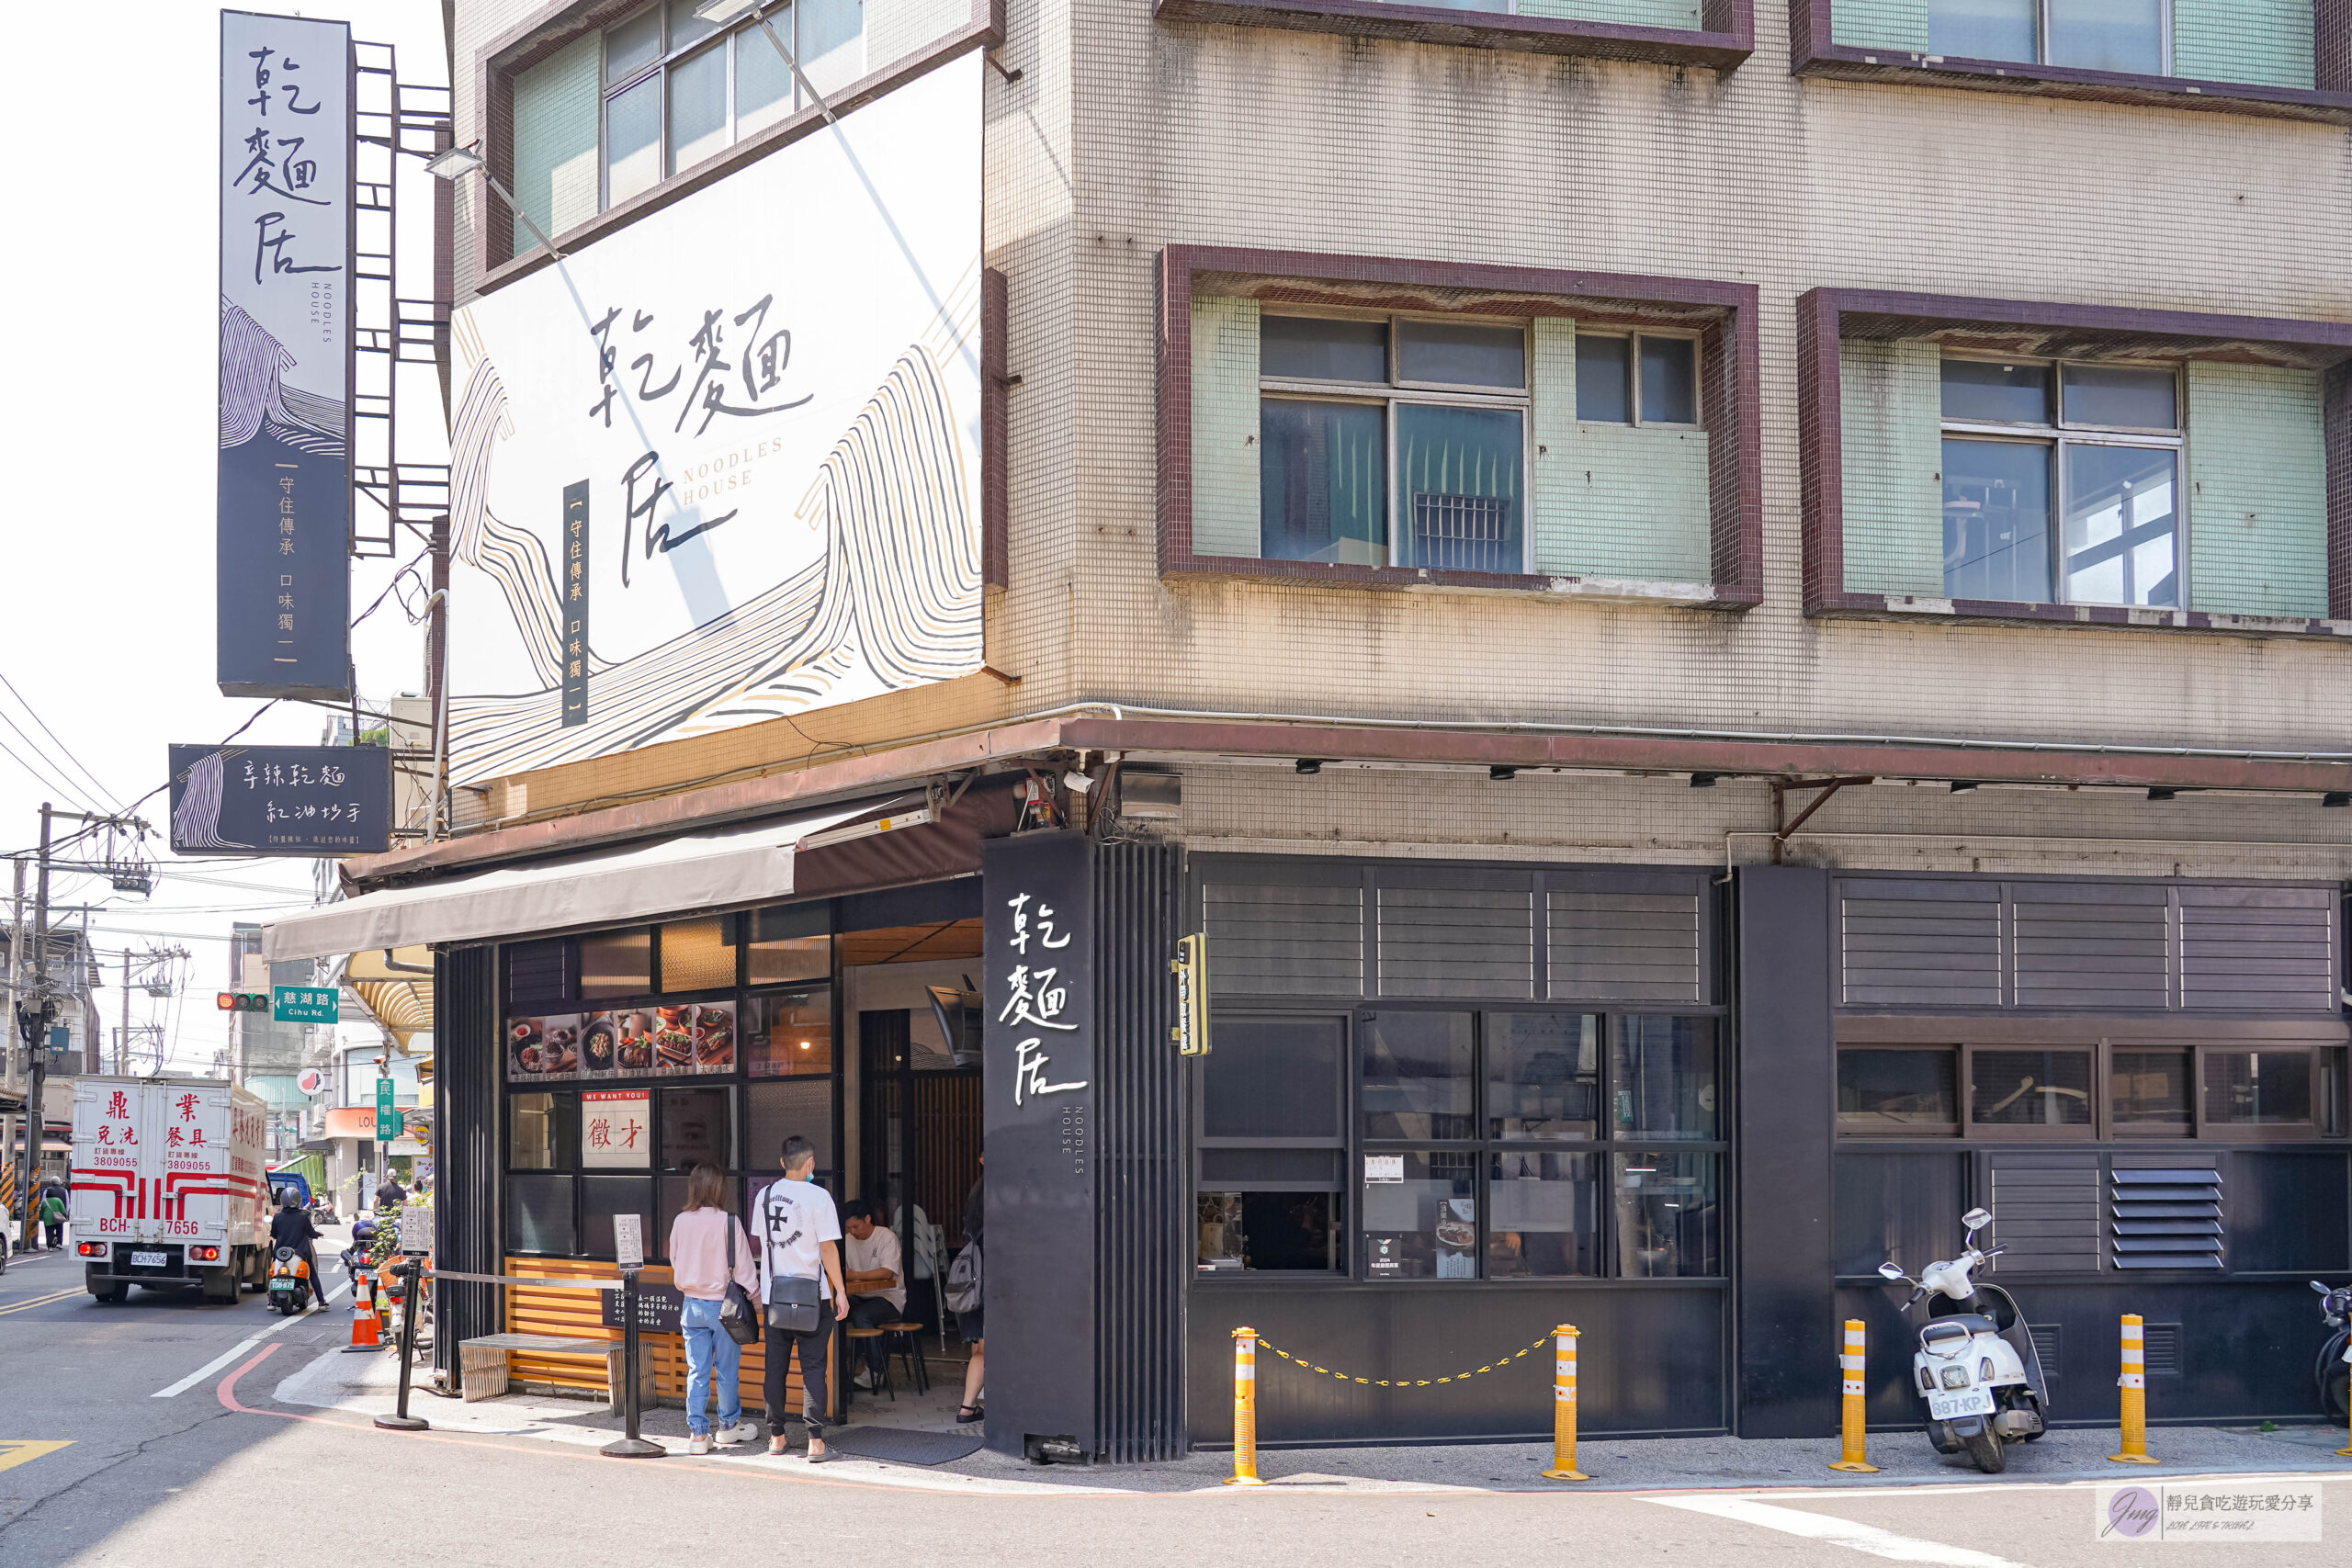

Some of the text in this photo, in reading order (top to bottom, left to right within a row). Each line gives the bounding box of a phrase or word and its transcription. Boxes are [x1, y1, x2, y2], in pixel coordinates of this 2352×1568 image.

[233, 47, 343, 285] 乾麵居
[311, 282, 320, 324] HOUSE
[323, 283, 332, 343] NOODLES
[589, 294, 814, 438] 乾麵
[684, 437, 782, 484] NOODLES
[684, 469, 752, 506] HOUSE
[621, 451, 738, 589] 居
[277, 476, 295, 644] 守住傳承 口味獨一
[243, 761, 345, 789] 辛辣乾麵
[266, 801, 361, 823] 紅油抄手
[284, 992, 329, 1006] 慈湖路
[999, 893, 1089, 1106] 乾麵居
[358, 1116, 377, 1128] LOU
[379, 1084, 391, 1135] 民權路
[96, 1125, 208, 1148] 免洗 餐具
[588, 1118, 642, 1150] 徵才
[1062, 1107, 1071, 1154] HOUSE
[1075, 1107, 1084, 1173] NOODLES
[94, 1156, 138, 1167] 3809055
[167, 1160, 210, 1170] 3809055
[166, 1221, 198, 1235] 7656
[1931, 1394, 1991, 1416] 887-KPJ
